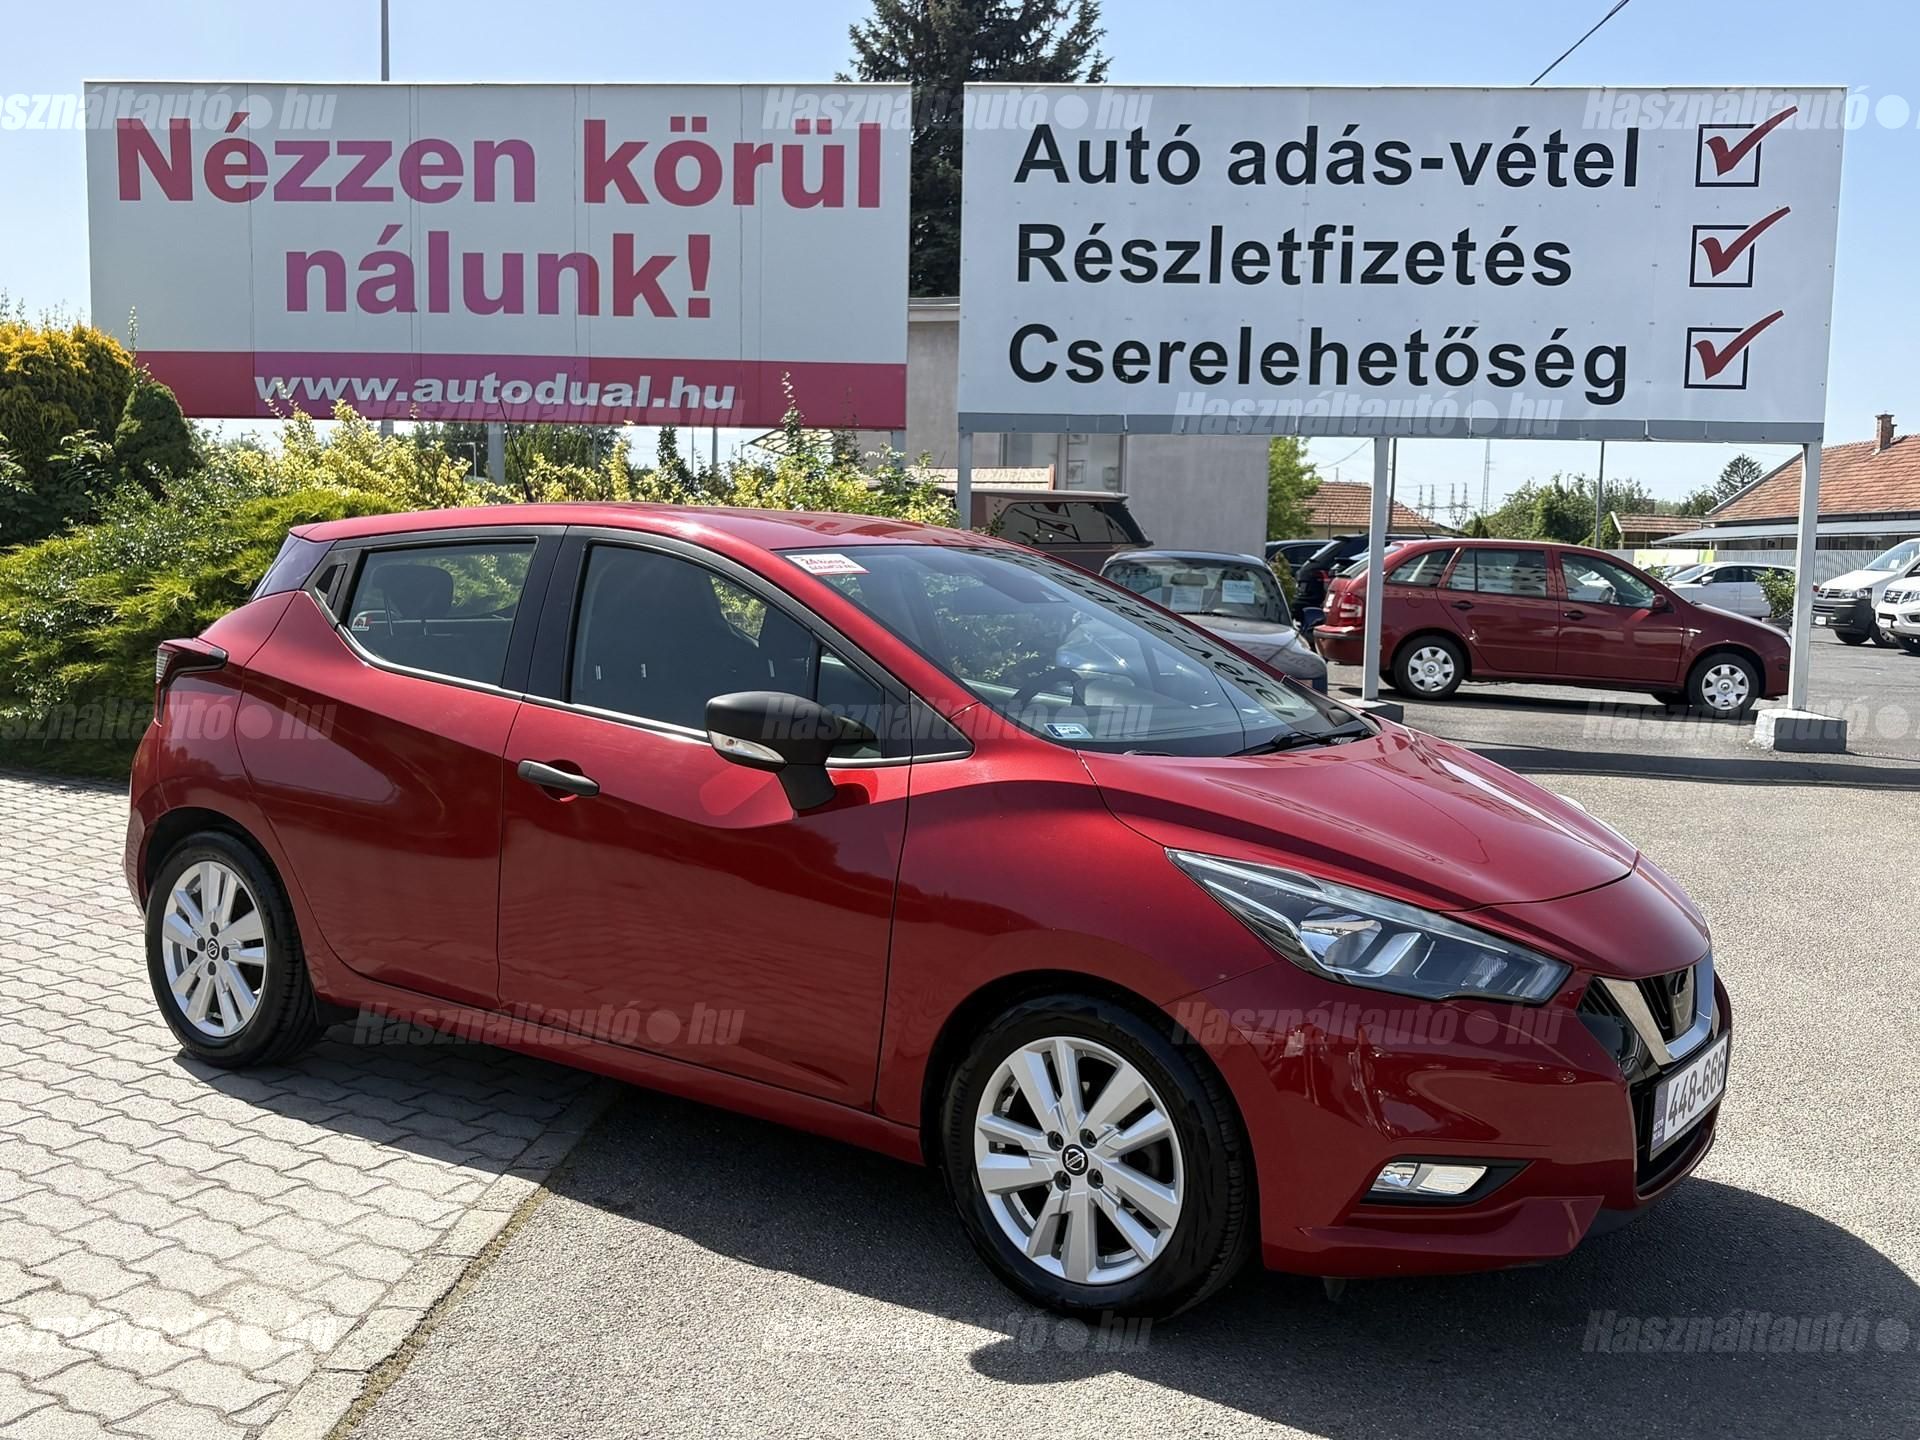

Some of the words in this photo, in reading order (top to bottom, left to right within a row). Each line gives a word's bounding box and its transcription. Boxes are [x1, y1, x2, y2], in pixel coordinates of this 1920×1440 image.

[117, 112, 536, 203] Nézzen
[584, 116, 881, 209] körül
[1014, 123, 1201, 186] Autó
[1228, 123, 1639, 188] adás-vétel
[286, 224, 711, 318] nálunk!
[1017, 221, 1573, 287] Részletfizetés
[255, 371, 736, 411] www.autodual.hu
[1009, 323, 1629, 404] Cserelehetőség
[1668, 1045, 1725, 1127] 448-666
